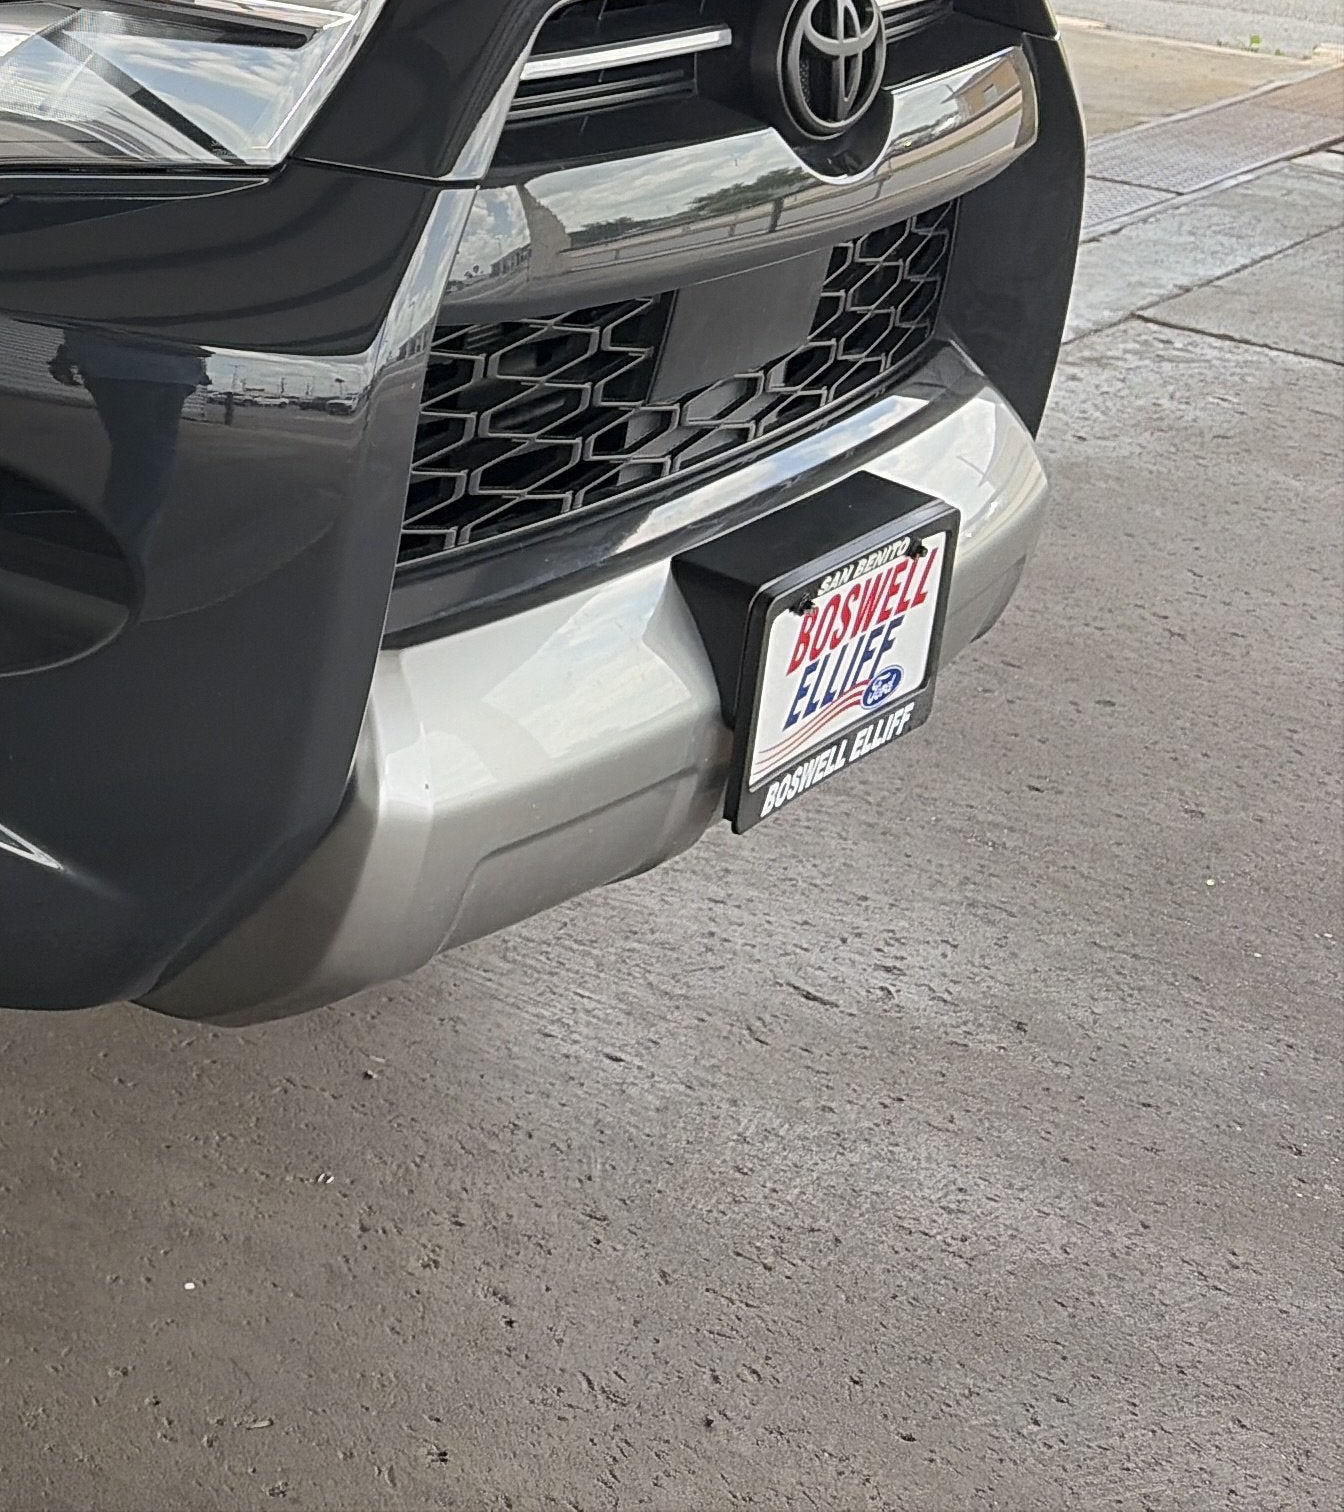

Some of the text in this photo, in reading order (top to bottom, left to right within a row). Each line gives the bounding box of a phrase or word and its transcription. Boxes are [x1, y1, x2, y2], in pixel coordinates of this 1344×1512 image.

[786, 547, 939, 677] BOSWELL
[817, 536, 911, 596] SAN BENITO
[783, 614, 905, 732] ELLIFF
[760, 702, 915, 818] BOSWELL ELLIFF
